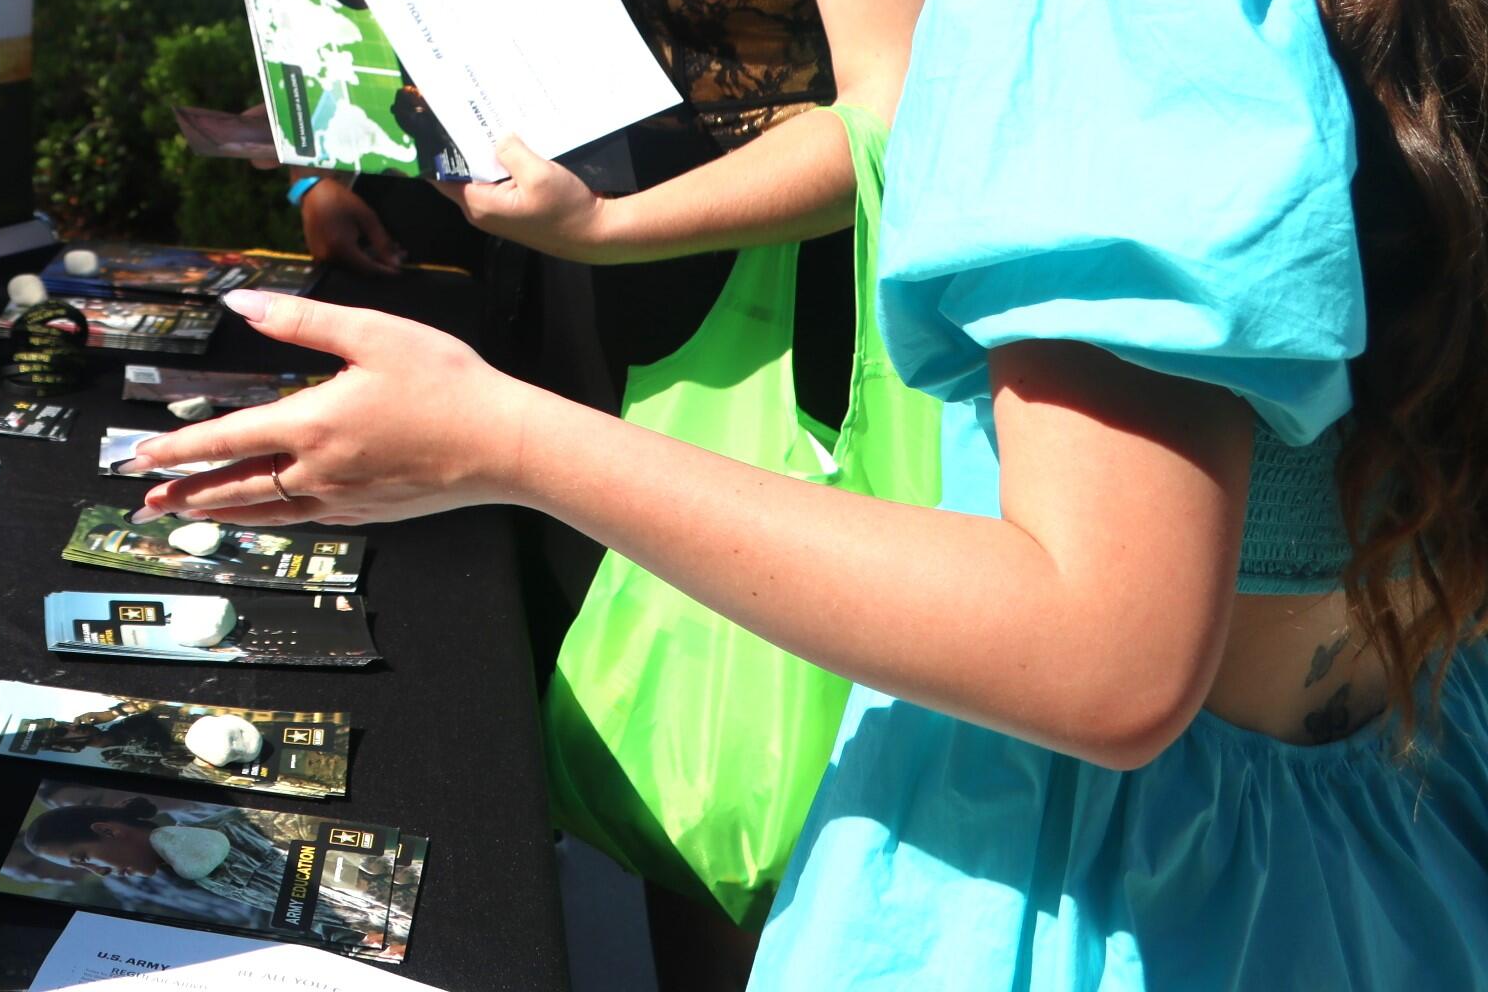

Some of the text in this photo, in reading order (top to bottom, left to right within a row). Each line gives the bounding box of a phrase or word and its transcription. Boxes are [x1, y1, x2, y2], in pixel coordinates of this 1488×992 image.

[405, 1, 423, 25] YOU
[420, 25, 435, 44] ALL
[432, 46, 444, 60] BE
[467, 100, 488, 128] ARMY
[285, 845, 316, 925] ARMY EDUCATION
[97, 951, 171, 971] U.S. ARMY
